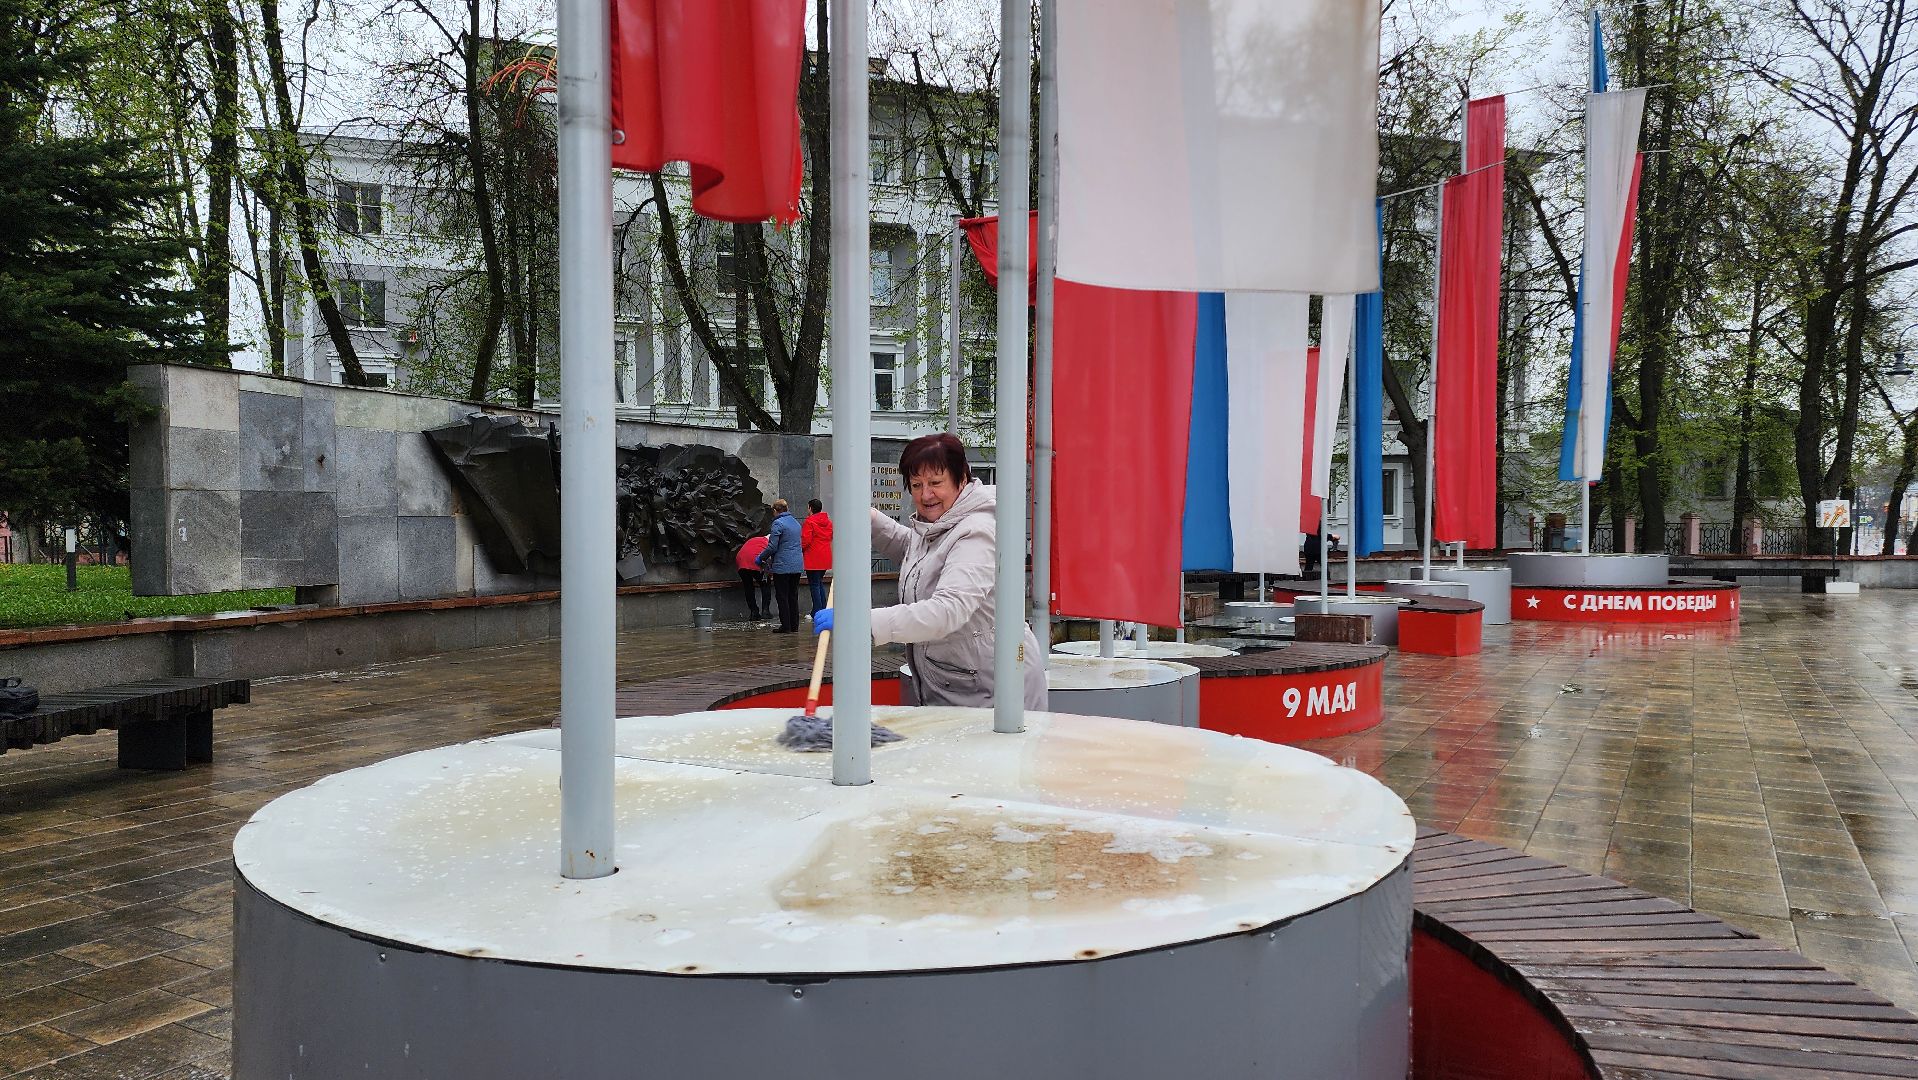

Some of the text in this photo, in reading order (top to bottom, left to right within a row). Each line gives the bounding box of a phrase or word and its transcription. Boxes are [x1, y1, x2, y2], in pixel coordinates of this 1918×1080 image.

[1563, 594, 1717, 613] С ДНЕМ ПОБЕДЫ
[1282, 681, 1357, 718] 9 МАЯ
